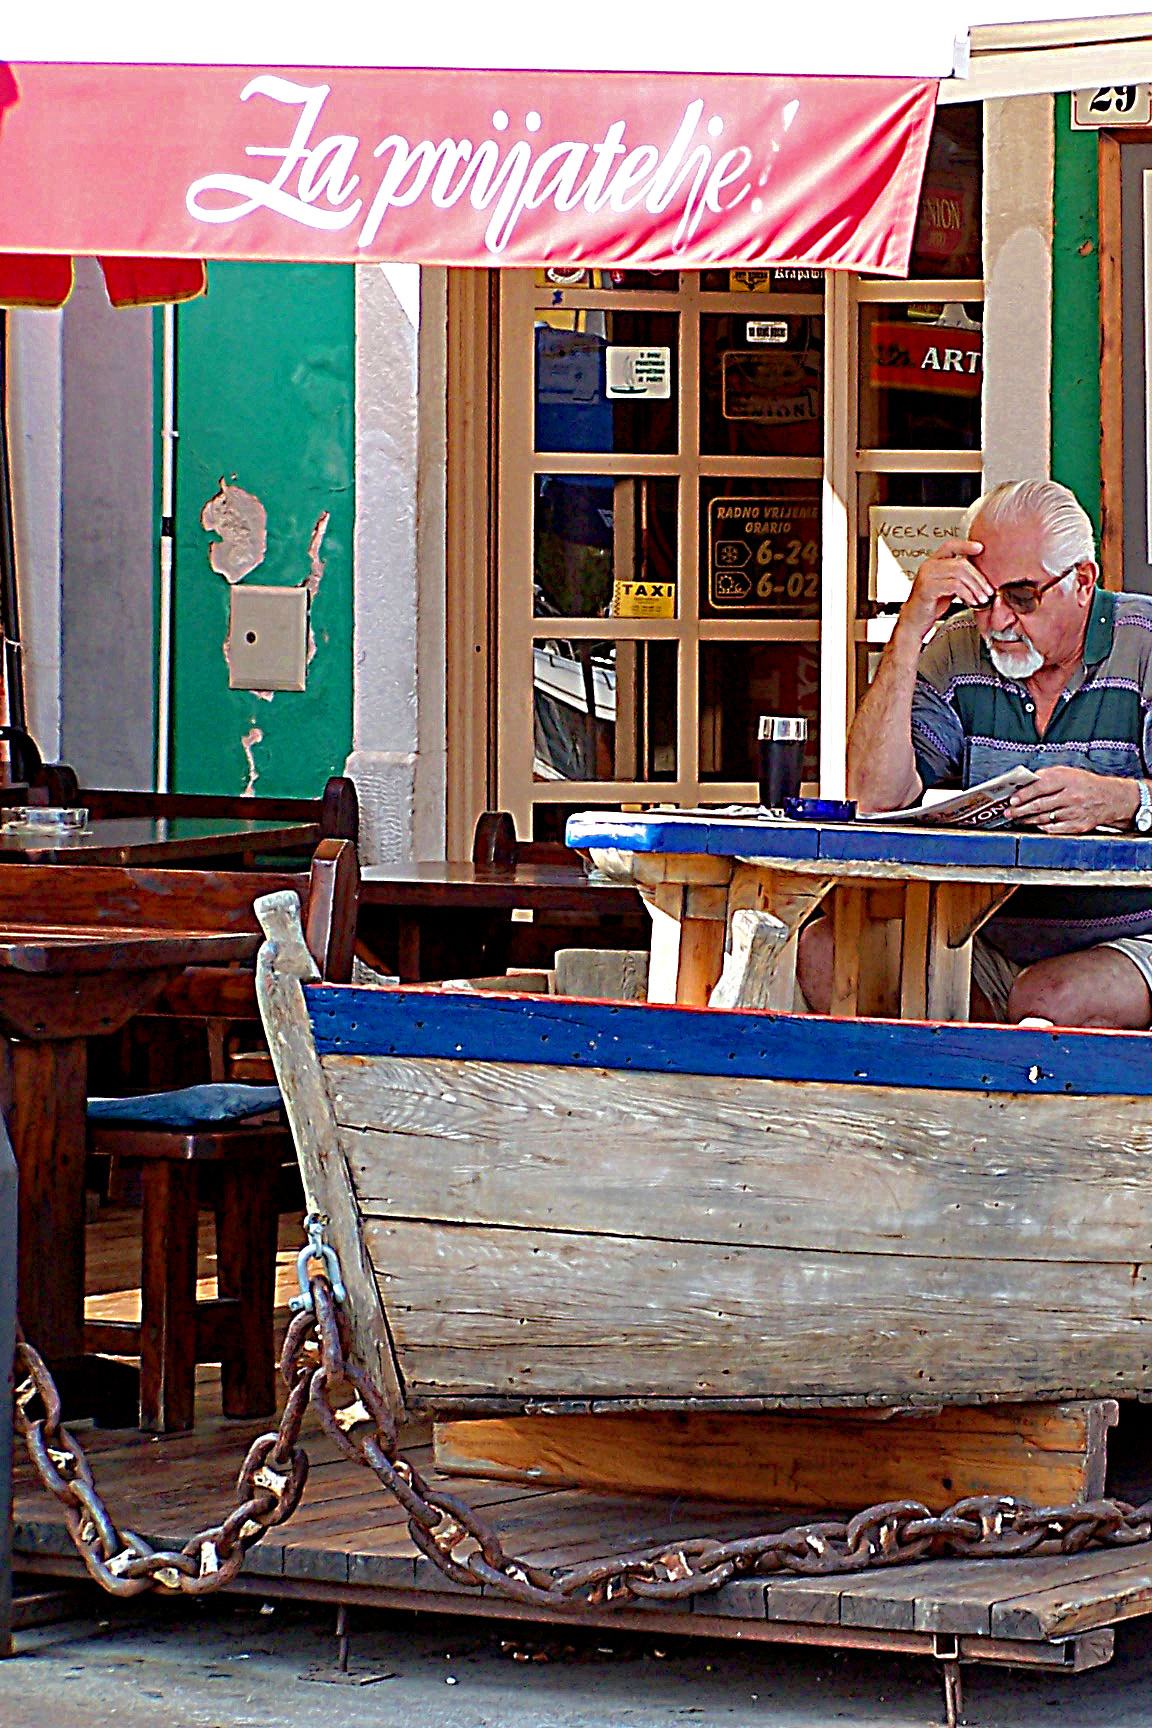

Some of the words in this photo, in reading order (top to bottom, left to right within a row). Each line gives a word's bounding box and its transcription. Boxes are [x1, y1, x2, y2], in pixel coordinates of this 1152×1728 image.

[1089, 86, 1136, 112] 29
[185, 74, 363, 231] Za
[358, 99, 800, 254] prijatelje!
[717, 507, 760, 520] RADNO
[745, 521, 792, 534] ORARIO
[877, 522, 930, 538] WEEK
[756, 539, 818, 565] 6-24
[622, 584, 673, 598] TAXI
[756, 572, 818, 598] 6-02
